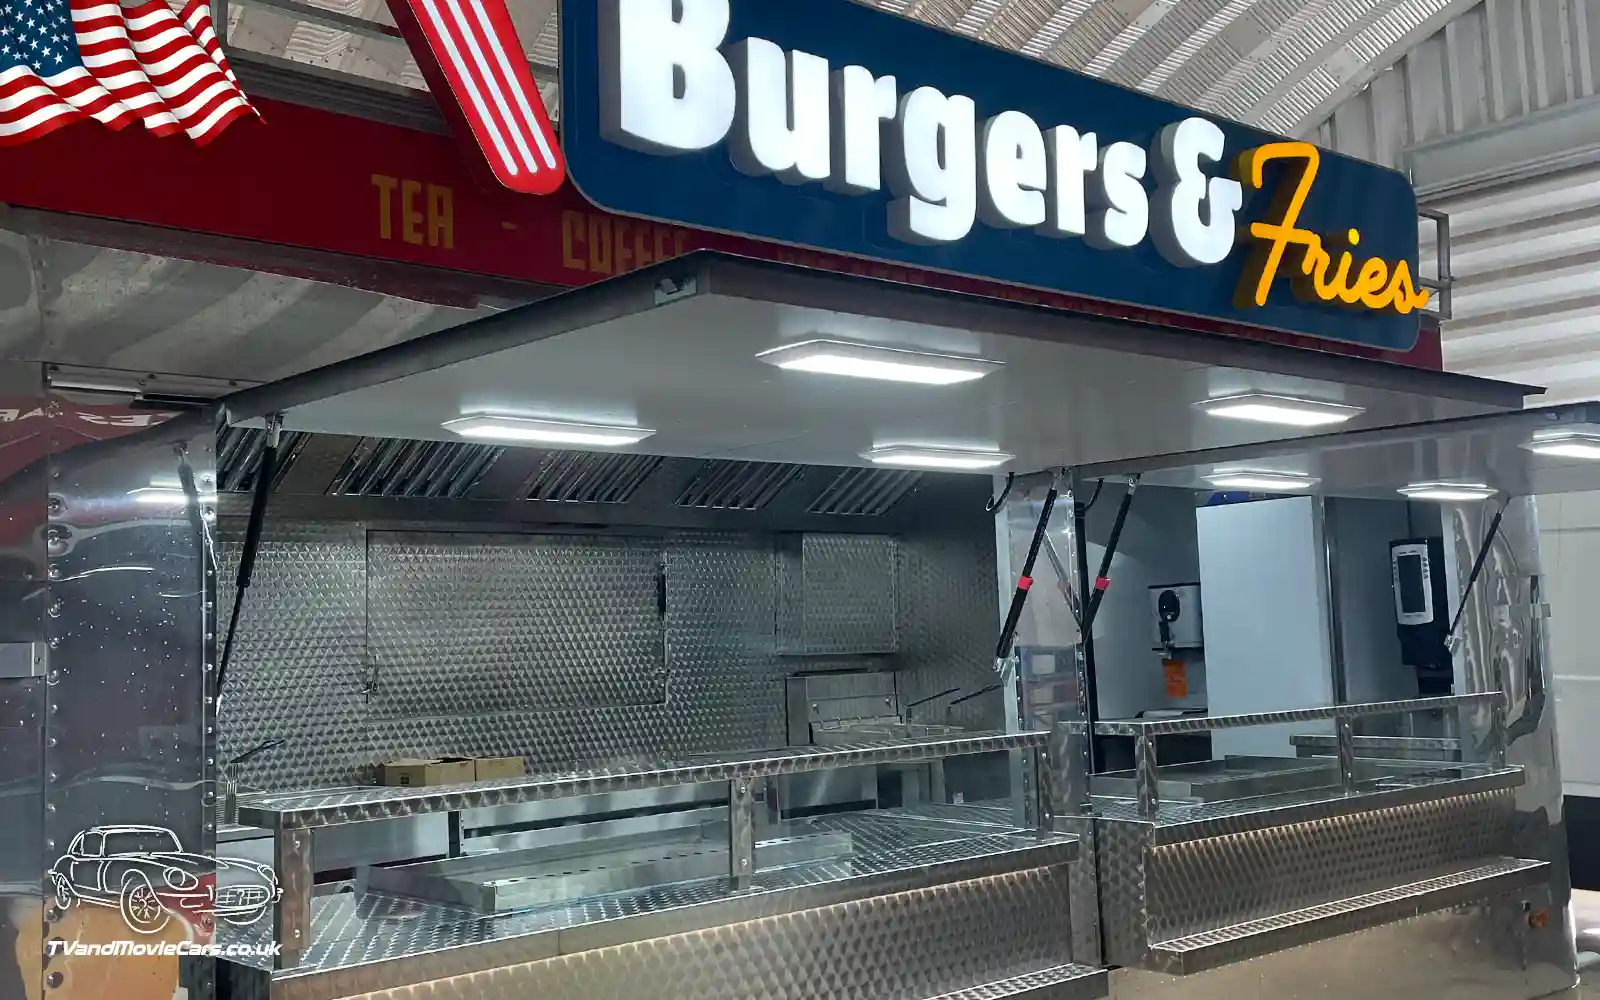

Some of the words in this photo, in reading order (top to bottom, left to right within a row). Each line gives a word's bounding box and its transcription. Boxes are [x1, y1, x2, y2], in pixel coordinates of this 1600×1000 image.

[371, 174, 454, 249] TEA
[612, 0, 1150, 247] Burgers
[1170, 116, 1243, 265] &
[1249, 141, 1431, 315] Fries
